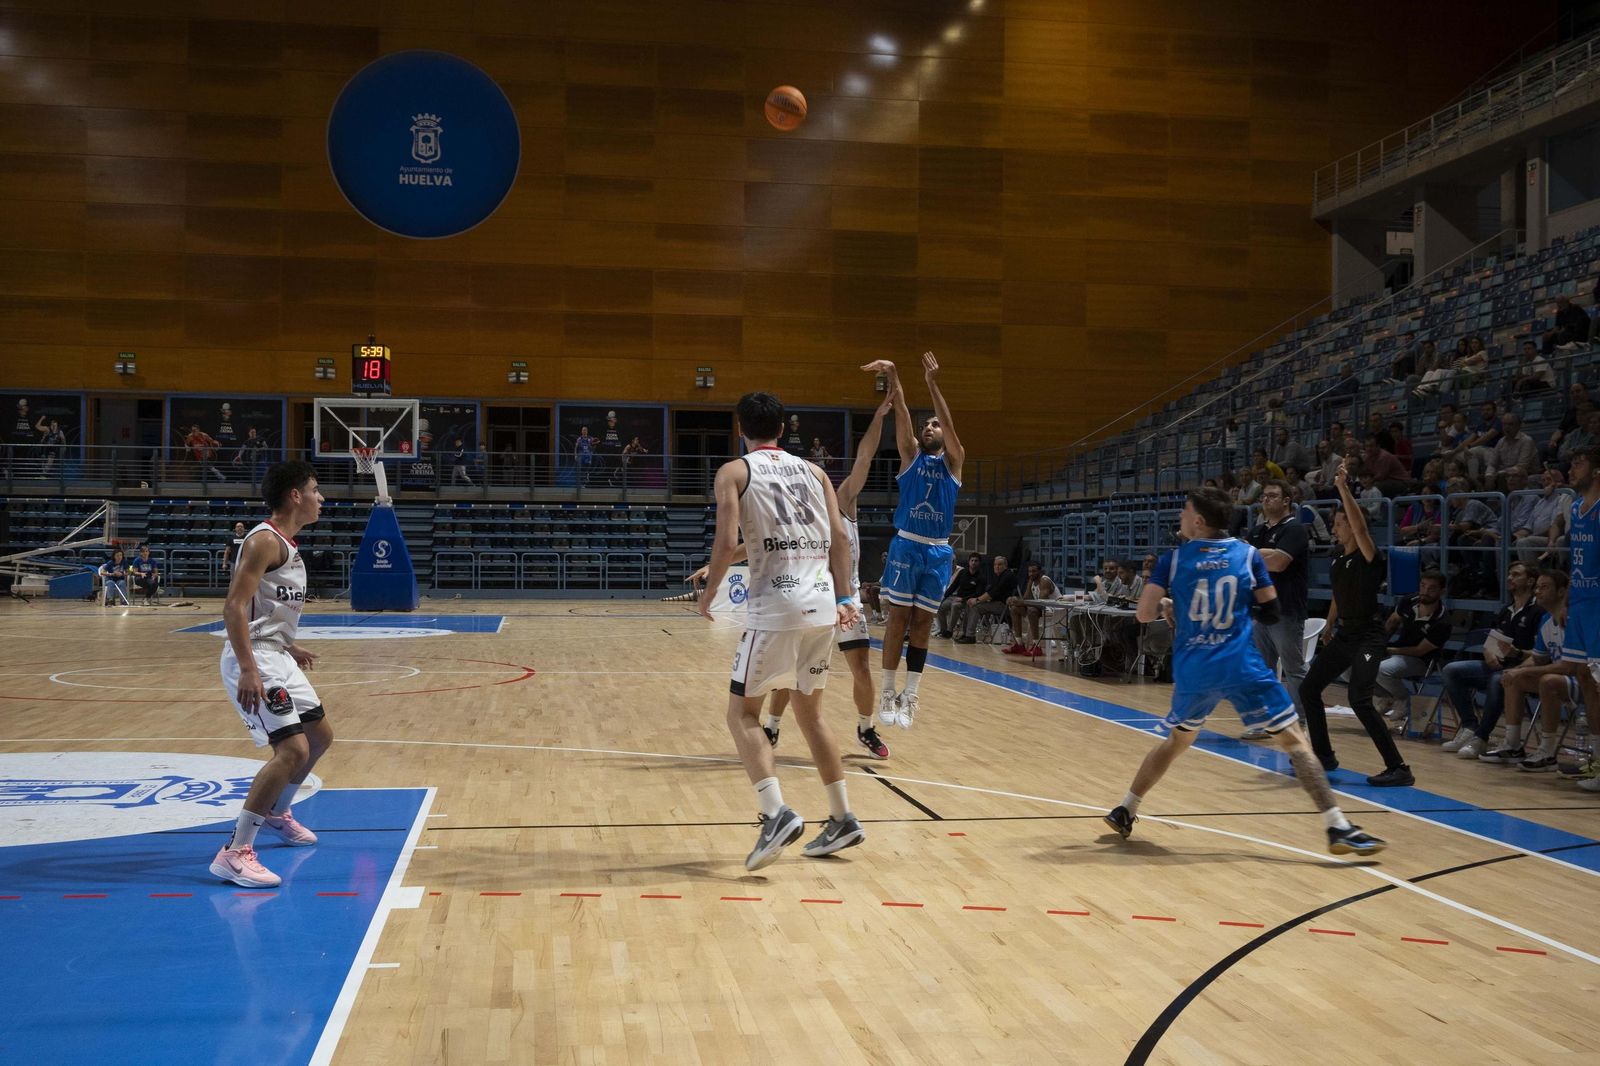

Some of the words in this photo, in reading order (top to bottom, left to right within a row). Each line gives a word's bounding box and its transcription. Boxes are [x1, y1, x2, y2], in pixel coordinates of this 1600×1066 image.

[399, 174, 453, 186] HUELVA
[360, 346, 383, 357] 5:39
[363, 360, 380, 379] 18
[926, 482, 934, 499] 7
[769, 482, 815, 525] 13
[763, 535, 830, 553] BieleGroup
[1573, 547, 1584, 565] 55
[893, 570, 901, 587] 7
[1188, 574, 1238, 631] 40
